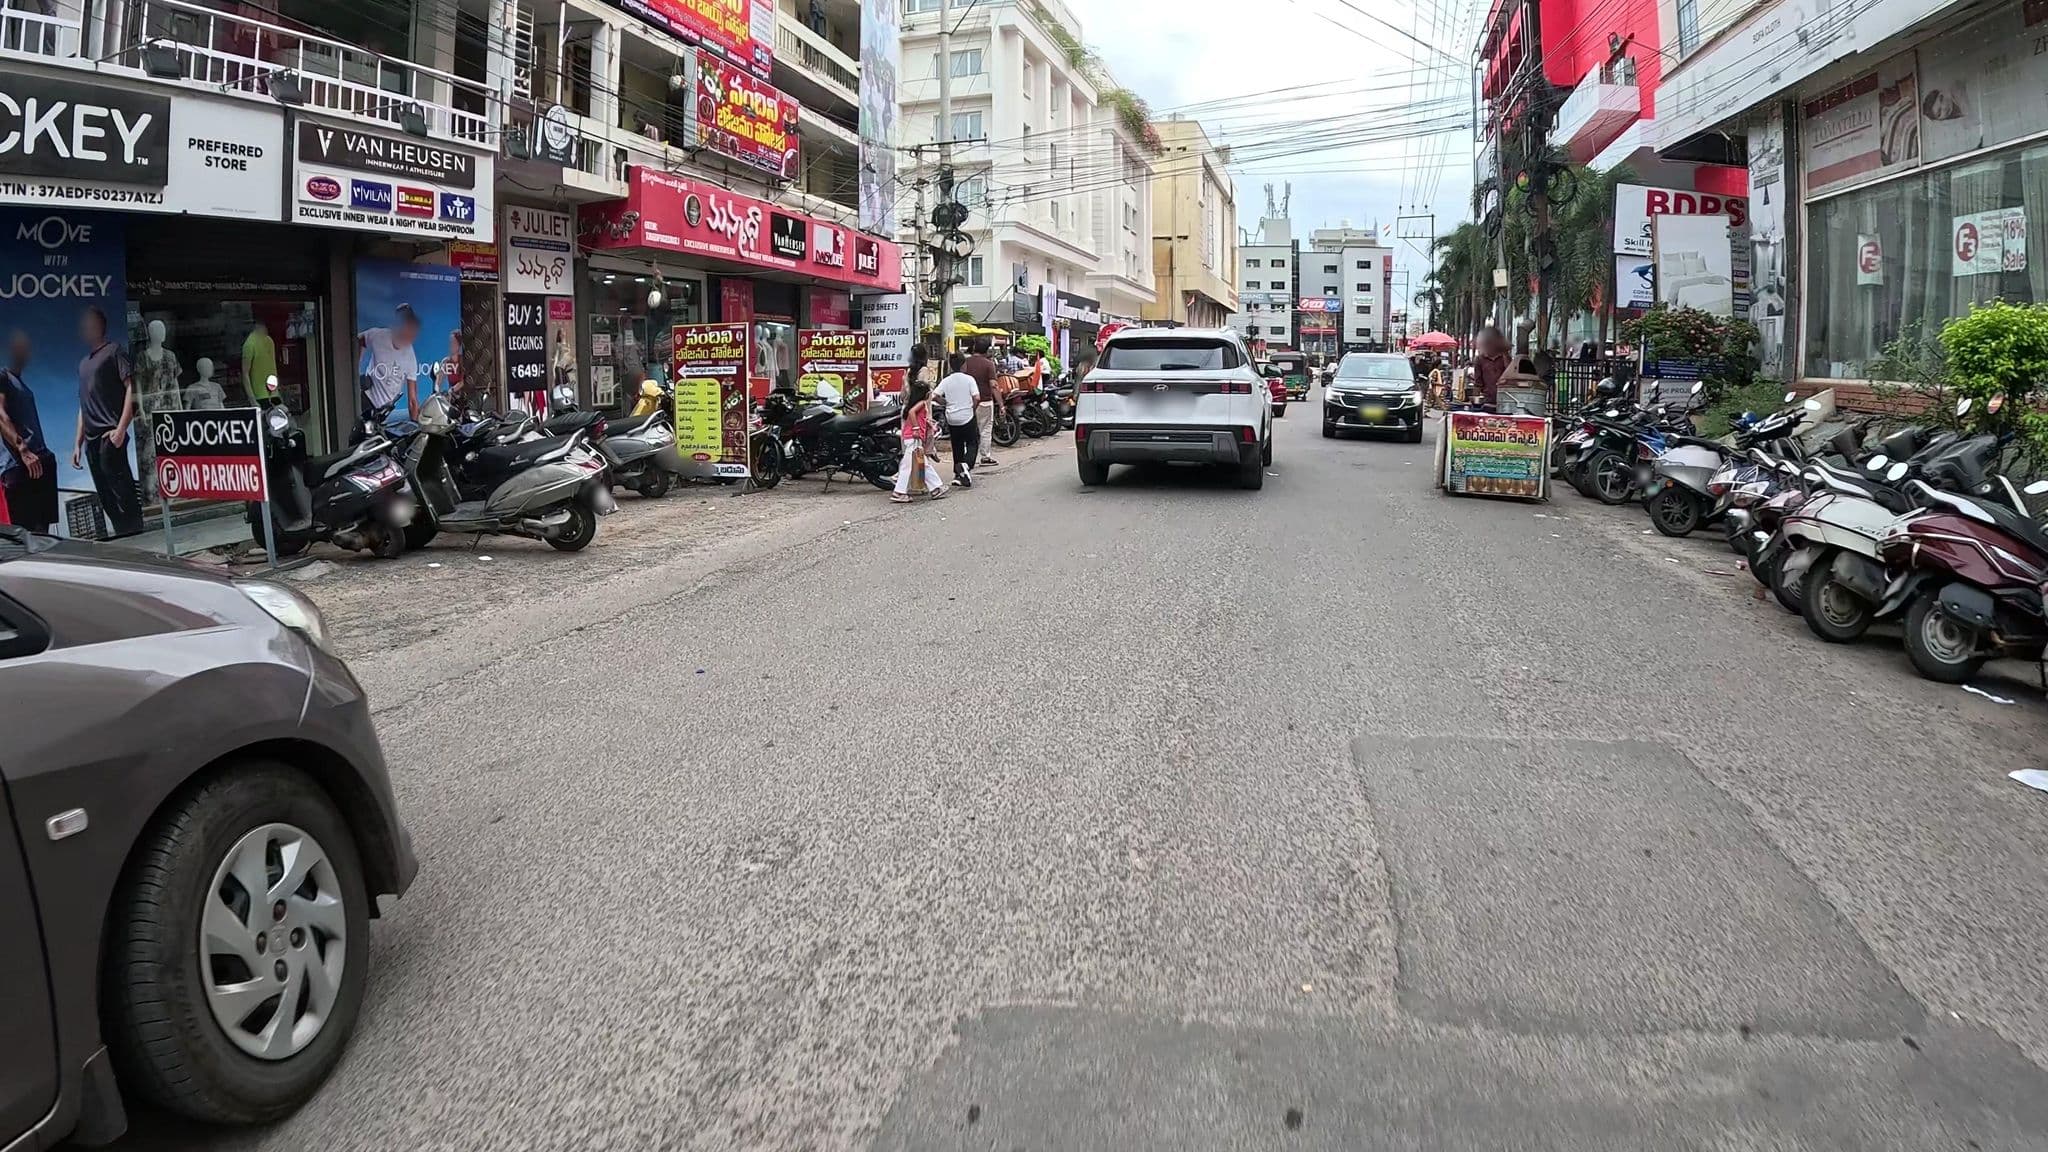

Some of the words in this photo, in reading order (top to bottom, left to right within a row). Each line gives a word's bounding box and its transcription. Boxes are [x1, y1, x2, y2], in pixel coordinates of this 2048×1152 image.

[188, 137, 264, 159] PREFERRED
[344, 132, 383, 157] VAN
[390, 142, 465, 173] HEUSEN
[204, 155, 248, 172] STORE
[408, 166, 445, 179] ATHLEISURE
[299, 207, 342, 221] EXCLUSIVE
[343, 212, 365, 223] INNER
[366, 214, 389, 226] WEAR
[396, 217, 416, 229] NIGHT
[417, 221, 437, 231] WEAR
[437, 223, 475, 235] SHOWROOM
[446, 206, 469, 220] VIP
[16, 216, 92, 249] MOVE
[523, 211, 570, 238] JULIET
[2003, 219, 2025, 240] 18%
[1624, 238, 1645, 247] Skill
[44, 255, 69, 267] WITH
[2003, 248, 2025, 269] Sale
[0, 274, 112, 298] JOCKEY
[508, 304, 532, 326] BUY
[535, 305, 543, 326] 3
[864, 303, 875, 311] BED
[876, 302, 898, 311] SHEETS
[864, 316, 887, 324] TOWELS
[686, 327, 733, 345] నందిని
[811, 331, 856, 346] నందిని
[886, 327, 909, 336] COVERS
[508, 335, 544, 351] LEGGINGS
[880, 341, 896, 349] MATS
[676, 345, 709, 362] భోజనం
[415, 362, 459, 376] JOKEY
[178, 419, 254, 447] JOCKEY
[181, 465, 201, 491] NO
[203, 463, 260, 493] PARKING
